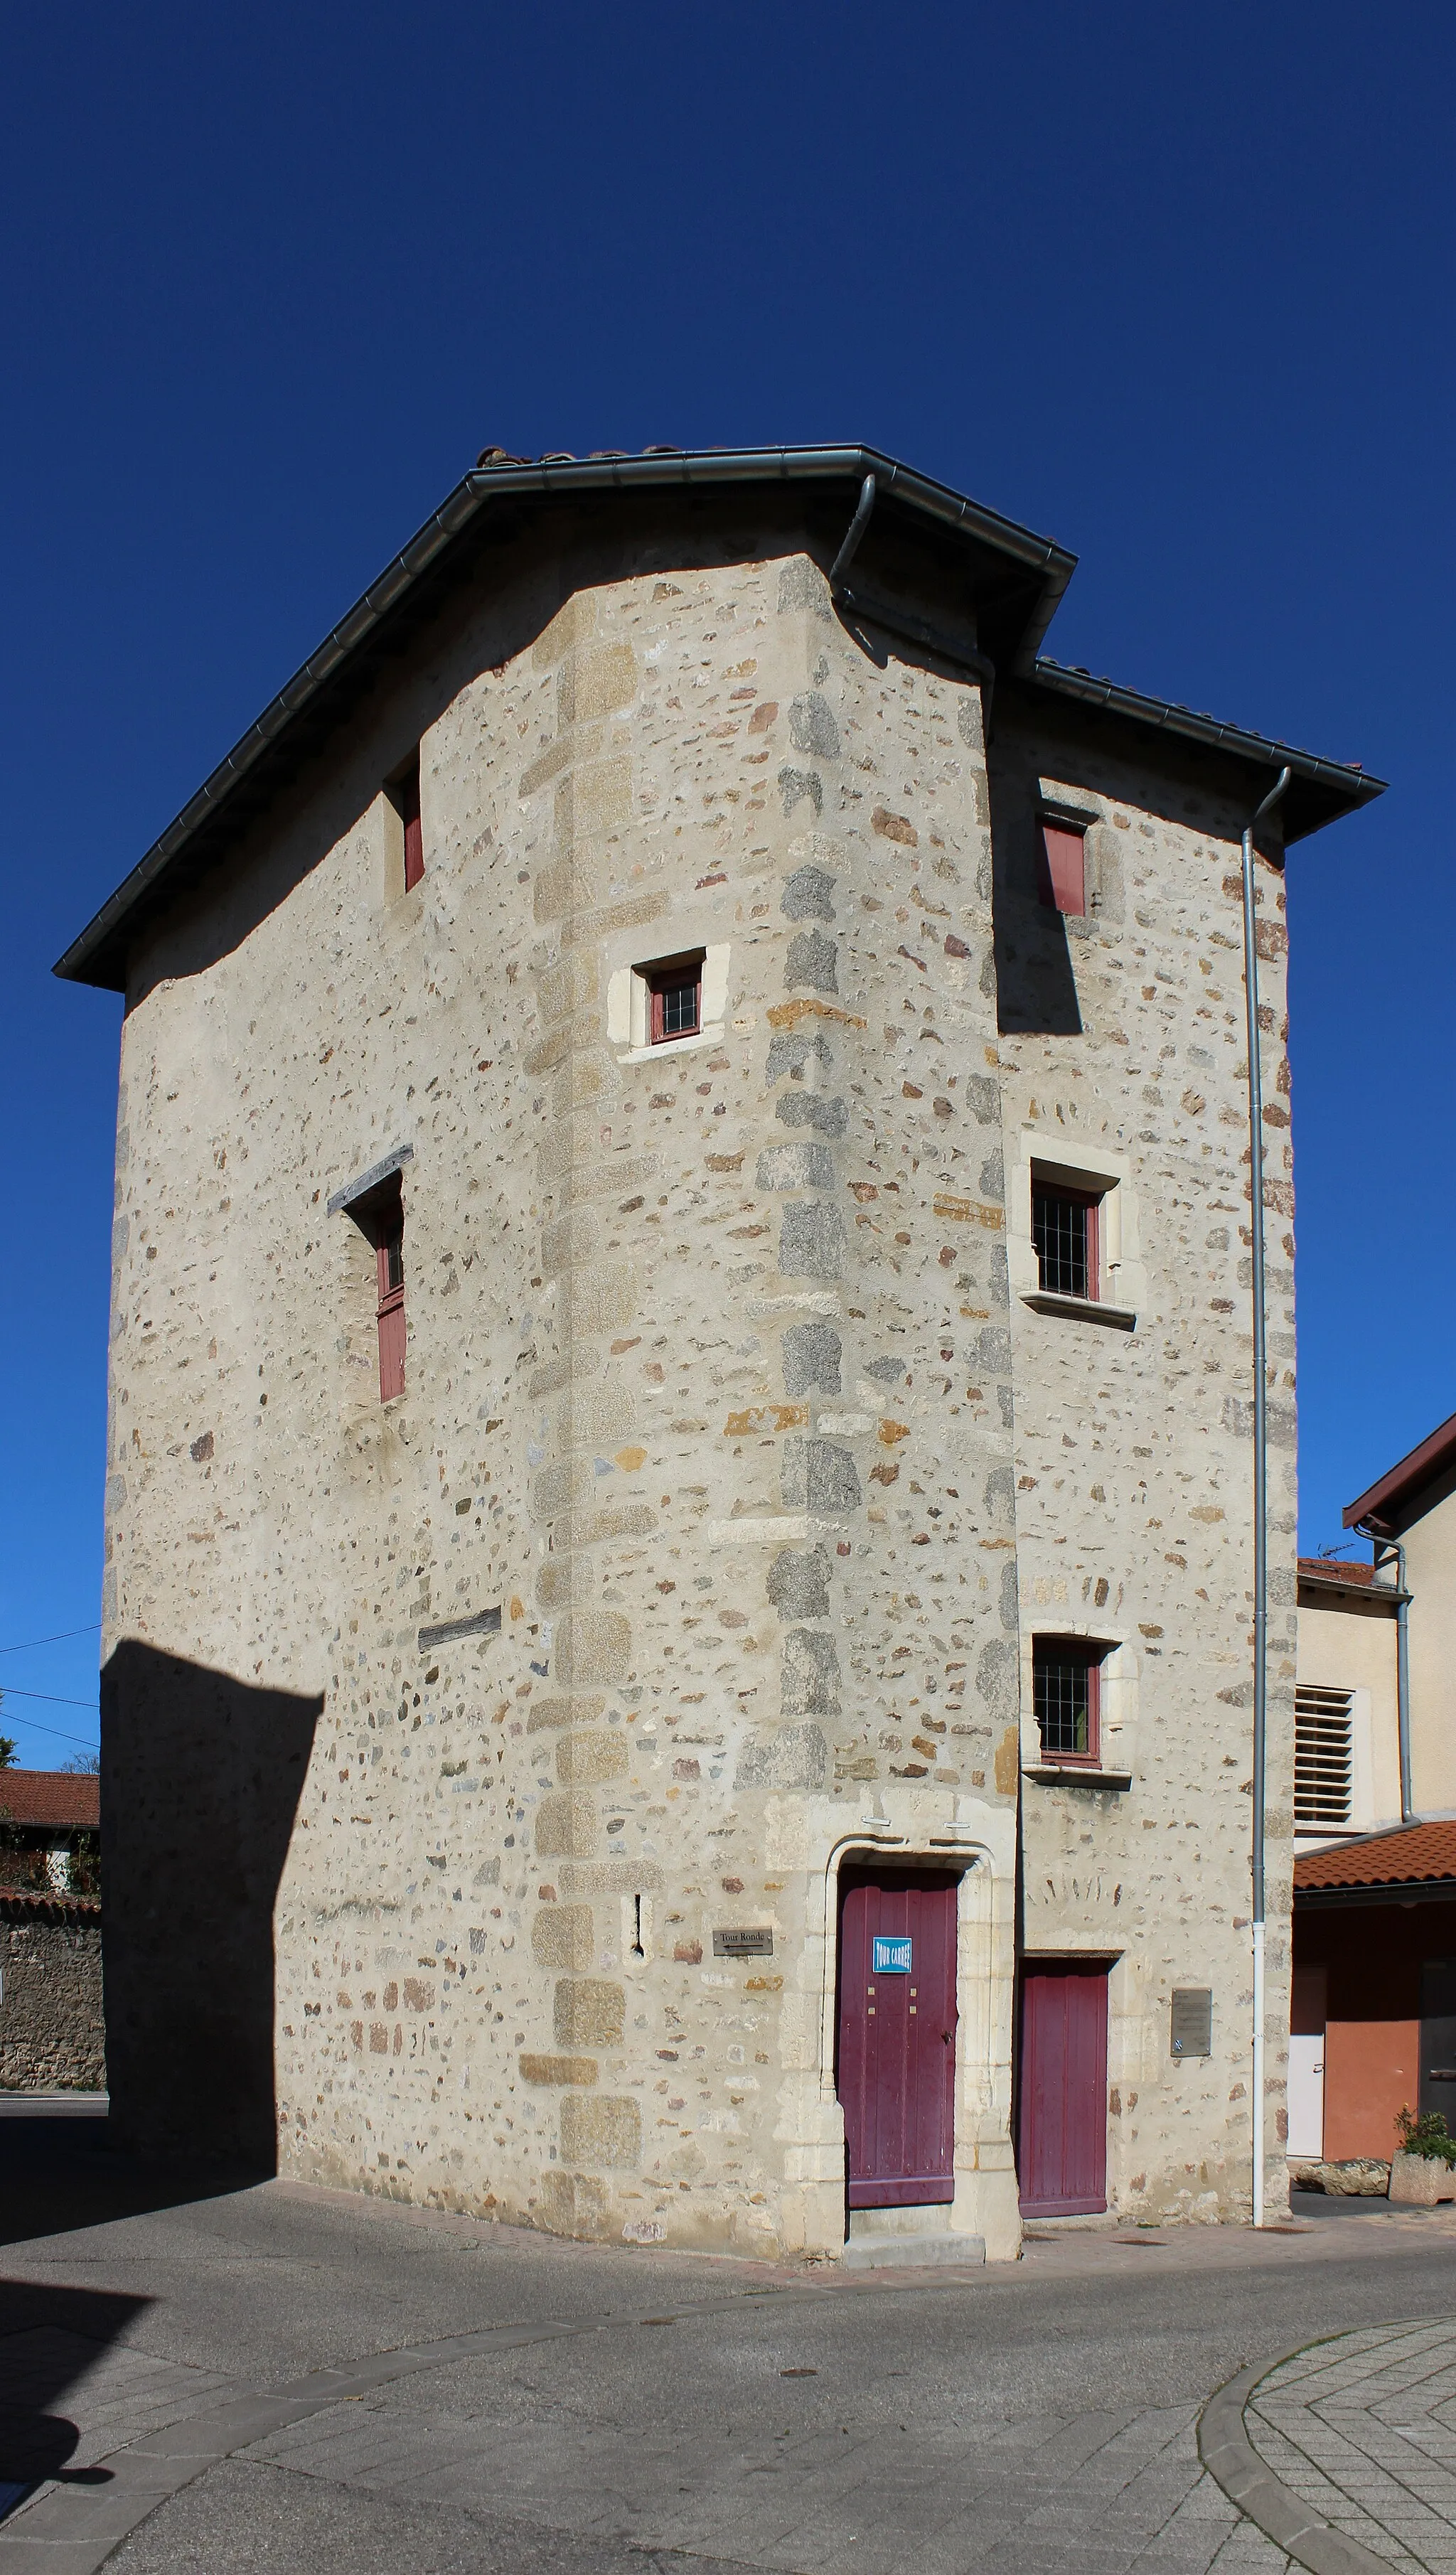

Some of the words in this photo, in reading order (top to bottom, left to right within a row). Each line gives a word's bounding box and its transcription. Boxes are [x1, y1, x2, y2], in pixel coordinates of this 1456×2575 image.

[720, 1933, 738, 1942] Tour
[740, 1932, 764, 1941] Ronde
[876, 1941, 890, 1969] TOUR
